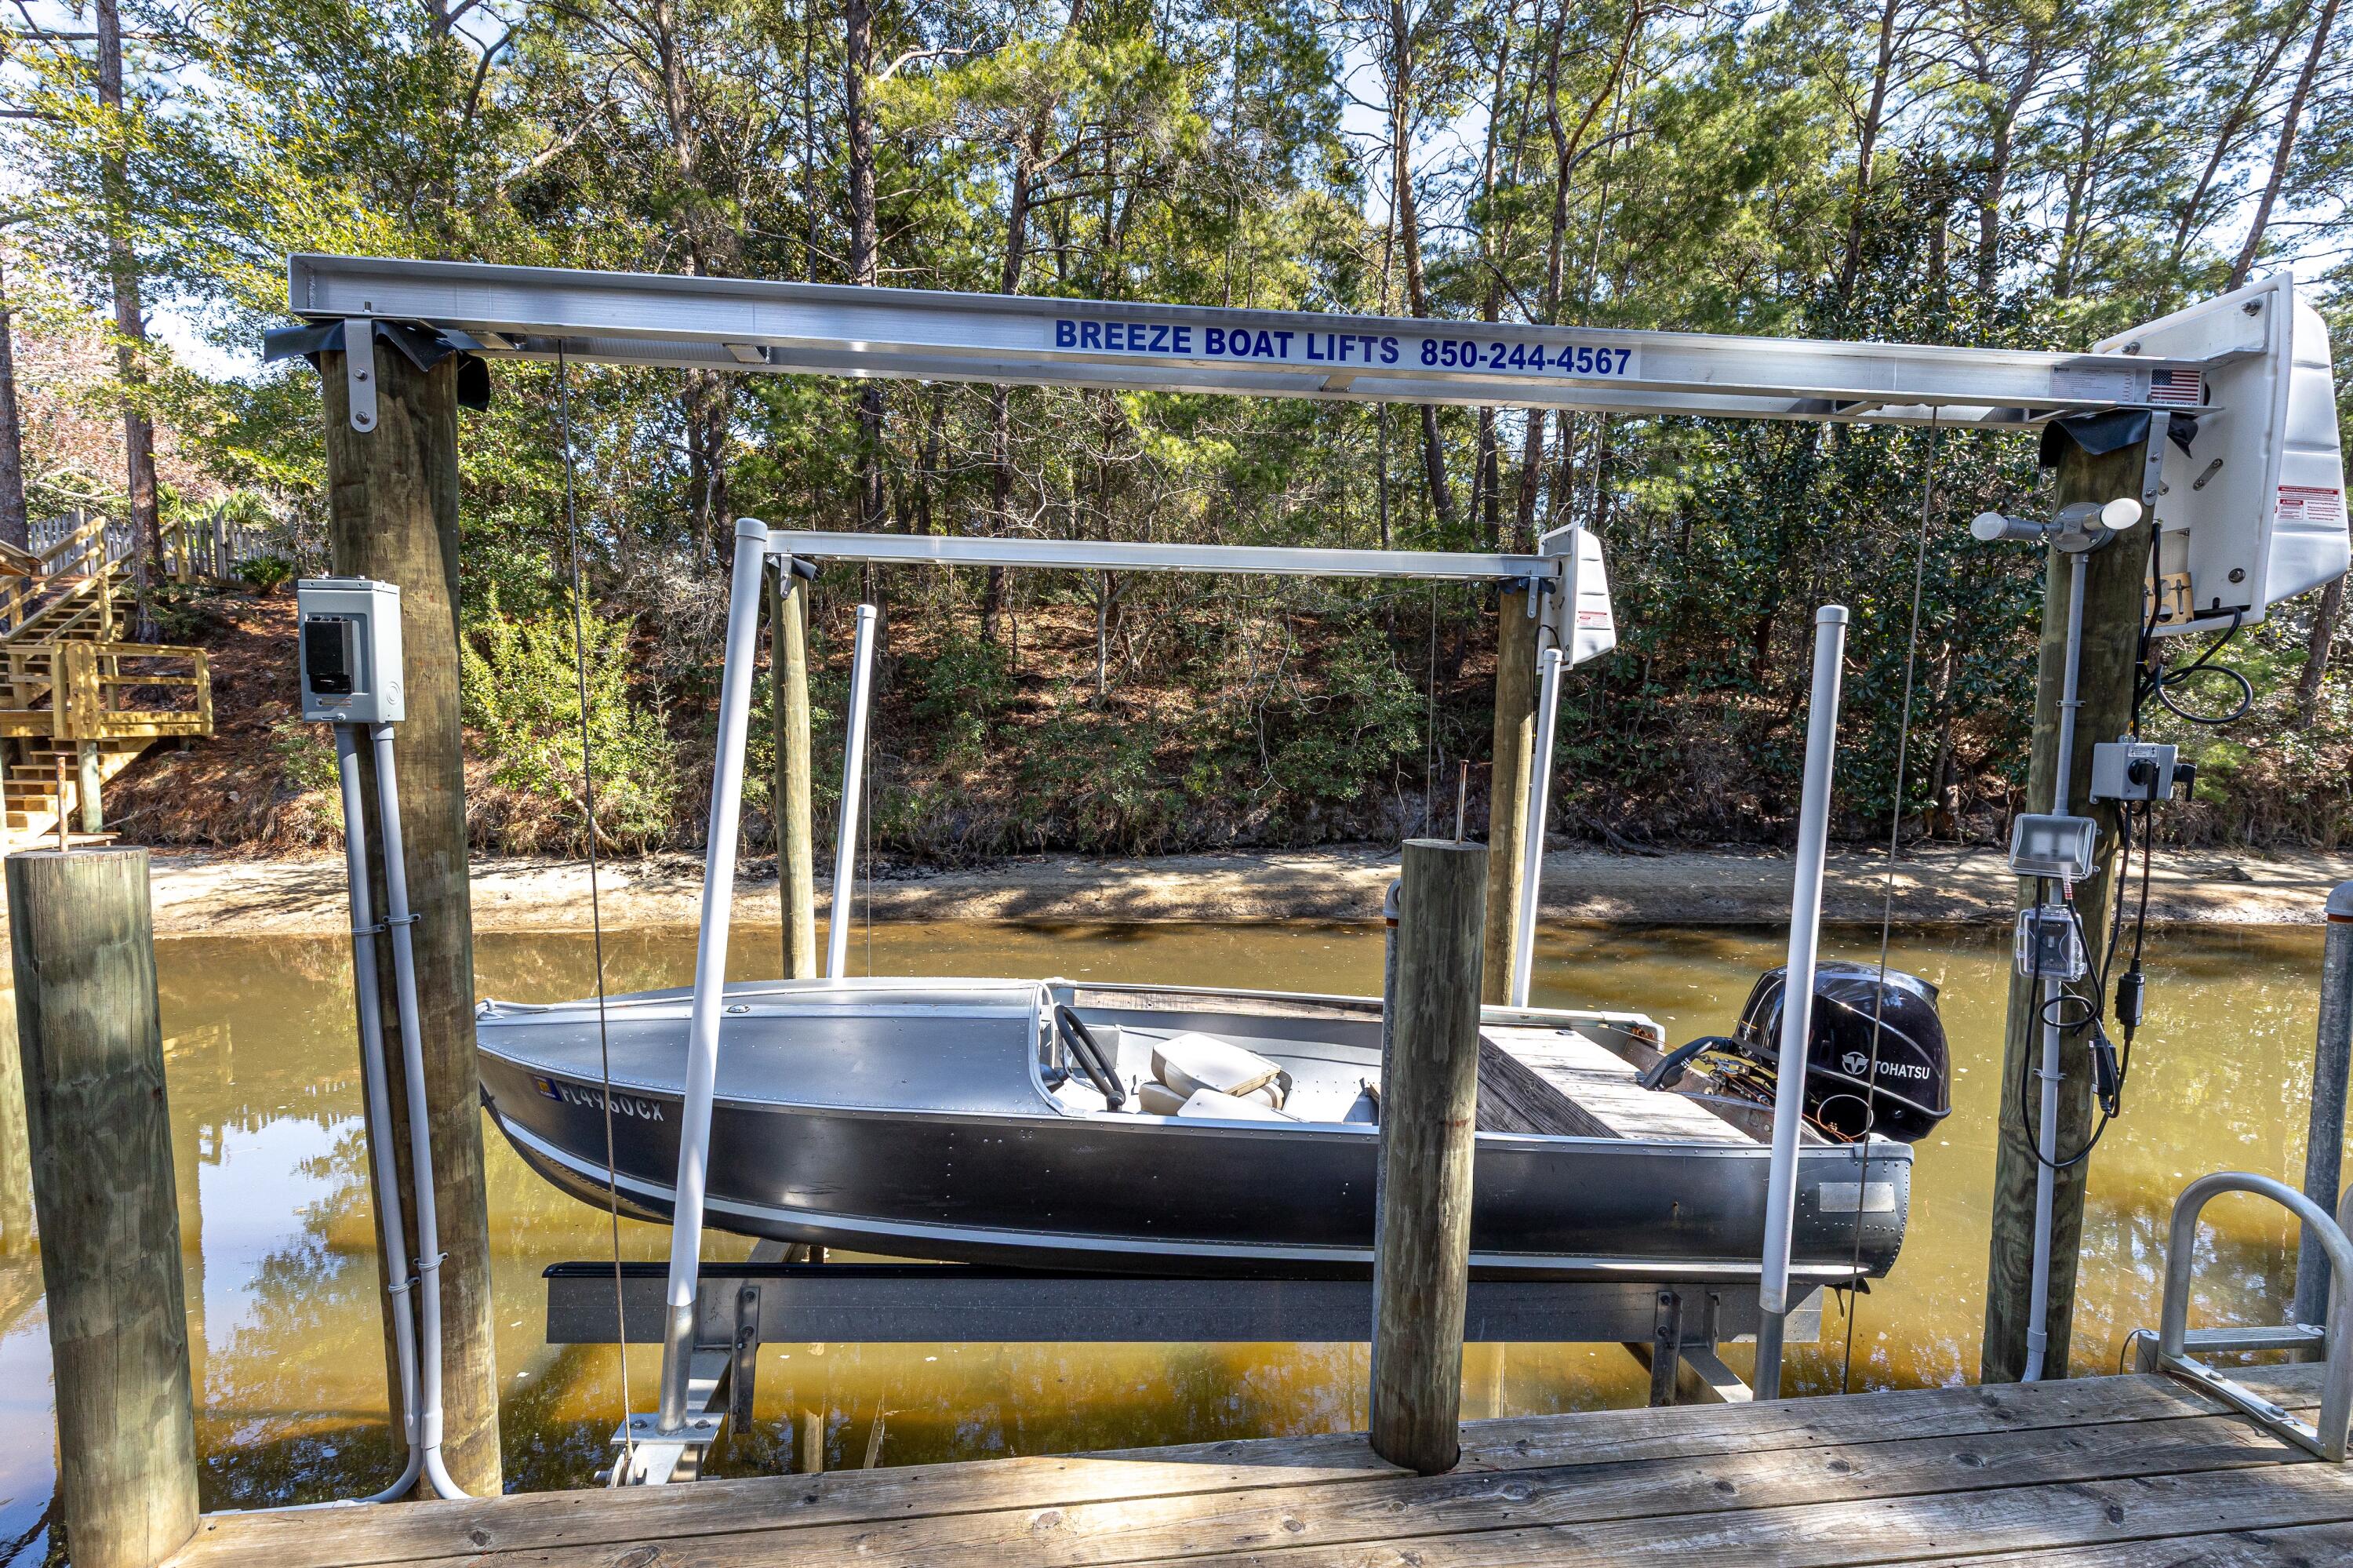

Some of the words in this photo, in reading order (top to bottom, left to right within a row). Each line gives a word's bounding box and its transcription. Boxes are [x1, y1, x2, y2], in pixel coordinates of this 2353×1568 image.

[1056, 319, 1191, 354] BREEZE
[1206, 327, 1293, 358] BOAT
[1307, 333, 1399, 364] LIFTS
[1420, 338, 1632, 375] 850-244-4567
[1875, 1060, 1930, 1079] TOHATSU
